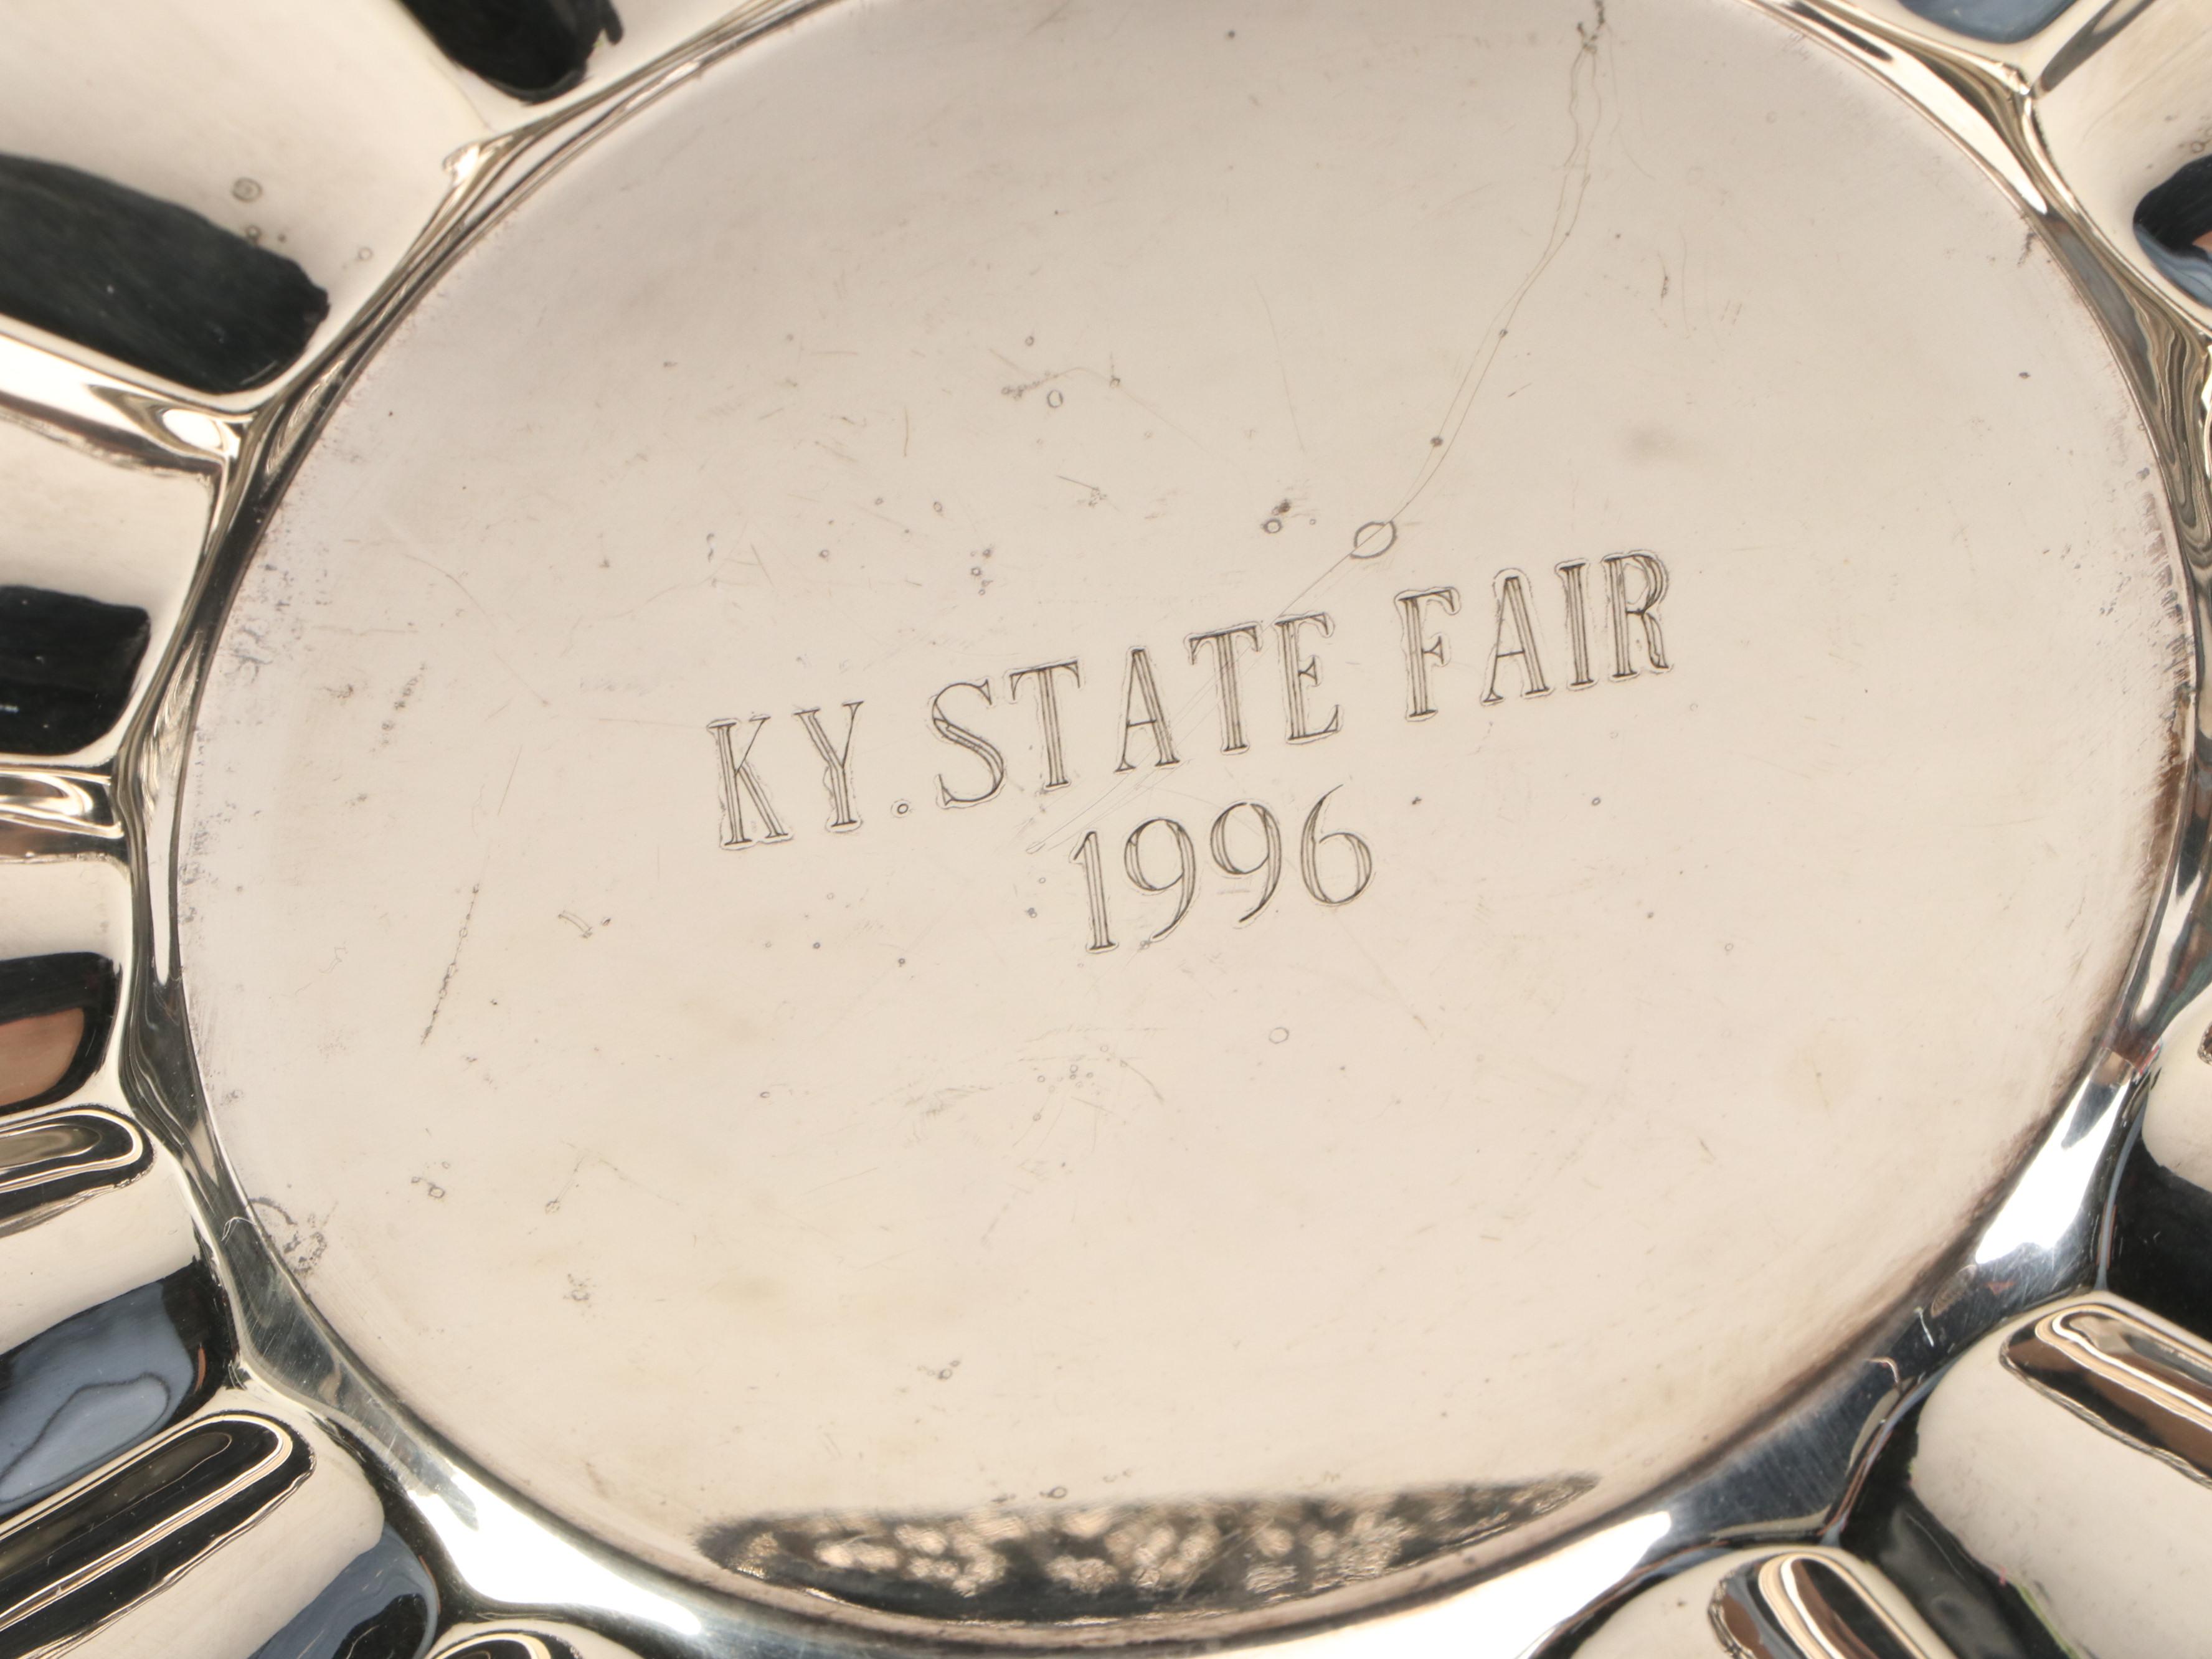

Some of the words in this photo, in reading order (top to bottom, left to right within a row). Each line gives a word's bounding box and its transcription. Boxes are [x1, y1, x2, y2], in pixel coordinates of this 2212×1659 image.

[706, 700, 910, 849] KY.
[930, 612, 1344, 808] STATE
[1394, 550, 1673, 721] FAIR
[1069, 784, 1374, 953] 1996
